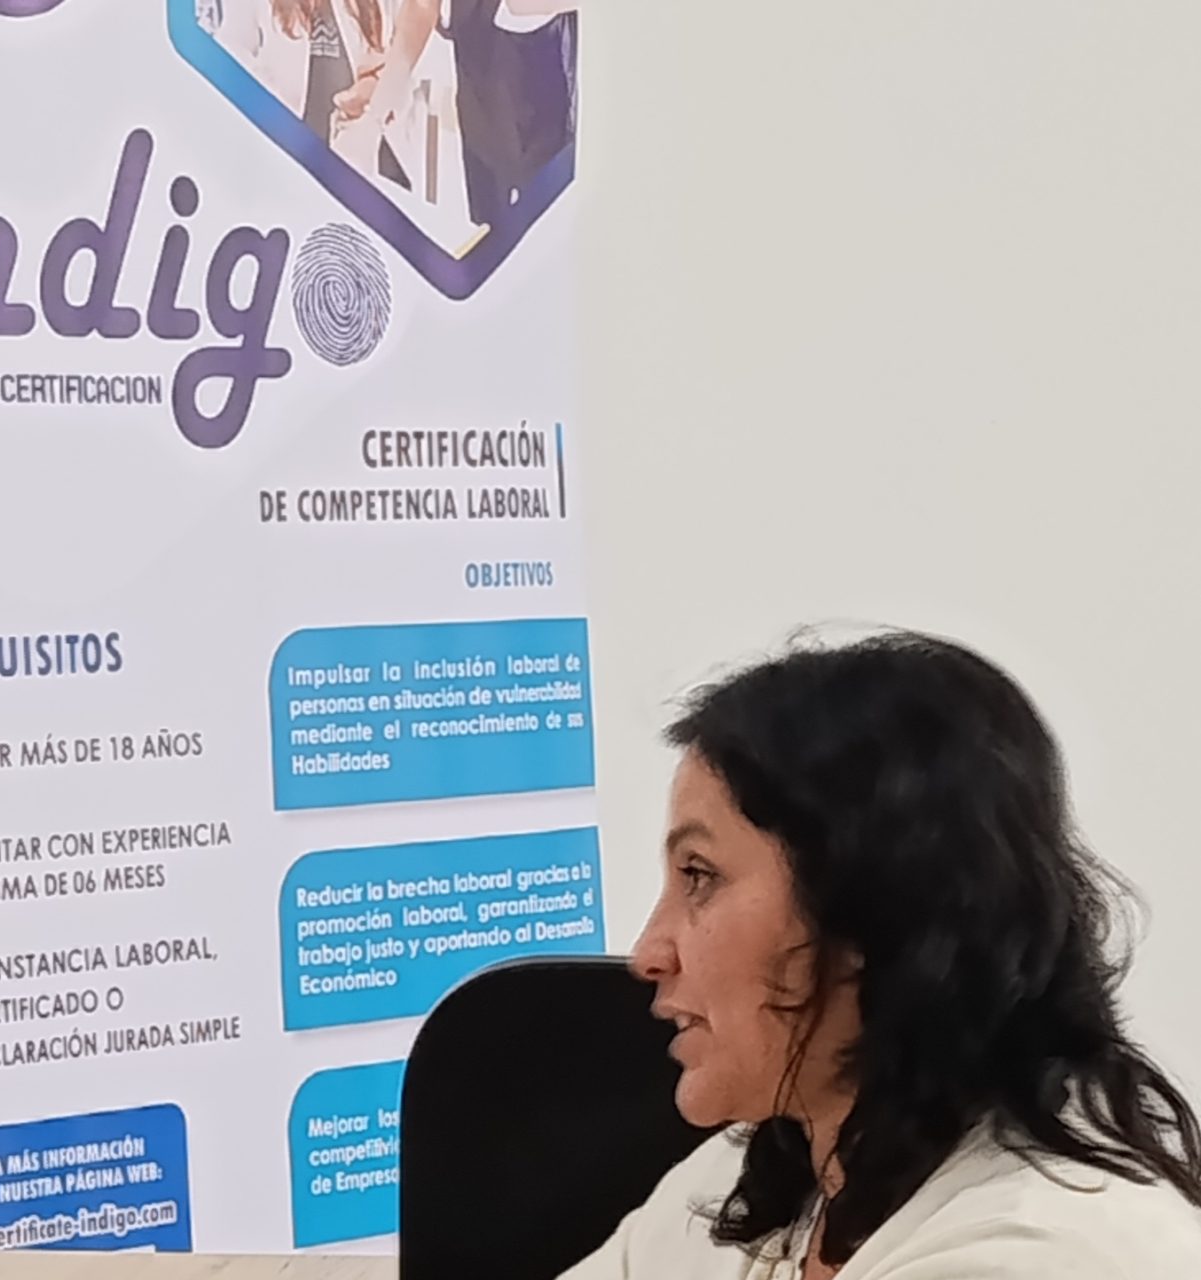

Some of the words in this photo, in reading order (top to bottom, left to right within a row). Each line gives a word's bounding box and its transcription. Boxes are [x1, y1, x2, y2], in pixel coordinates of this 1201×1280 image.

[0, 374, 162, 405] CERTIFICACION
[362, 420, 546, 468] CERTIFICACIÓN
[259, 490, 288, 522] DE
[297, 488, 458, 521] COMPETENCIA
[467, 487, 550, 519] LABORAL
[465, 562, 554, 588] OBJETIVOS
[288, 663, 371, 689] Impulsar
[382, 662, 401, 682] la
[414, 656, 496, 681] inclusión
[507, 654, 560, 675] laboral
[565, 653, 581, 672] de
[289, 694, 366, 720] personas
[368, 694, 391, 712] en
[393, 684, 466, 711] situación
[468, 684, 492, 706] de
[291, 723, 373, 746] mediante
[384, 720, 400, 741] el
[411, 712, 539, 739] reconocimiento
[545, 710, 562, 730] de
[20, 733, 68, 767] MÁS
[74, 738, 101, 763] DE
[109, 736, 135, 761] 18
[141, 728, 204, 760] AÑOS
[291, 750, 391, 775] Habilidades
[47, 832, 95, 860] CON
[102, 822, 232, 855] EXPERIENCIA
[44, 873, 69, 898] DE
[72, 870, 97, 895] 06
[103, 864, 166, 891] MESES
[296, 886, 363, 908] Reducir
[367, 884, 384, 902] la
[387, 876, 450, 900] brecha
[454, 869, 513, 893] laboral
[516, 864, 570, 892] gracias
[297, 908, 392, 941] promoción
[403, 902, 468, 926] laboral,
[477, 890, 578, 923] garantizando
[583, 887, 594, 906] el
[115, 936, 219, 969] LABORAL,
[298, 944, 362, 968] trabajo
[365, 937, 404, 964] justo
[408, 939, 420, 959] y
[424, 925, 511, 957] aportando
[515, 922, 532, 943] al
[106, 986, 125, 1011] O
[300, 967, 398, 996] Económico
[103, 1024, 175, 1055] JURADA
[179, 1016, 241, 1047] SIMPLE
[308, 1114, 369, 1139] Mejorar
[7, 1149, 40, 1176] MÁS
[43, 1135, 146, 1170] INFORMACIÓN
[0, 1174, 63, 1203] NUESTRA
[66, 1165, 125, 1193] PÁGINA
[127, 1162, 163, 1184] WEB:
[310, 1175, 332, 1195] de
